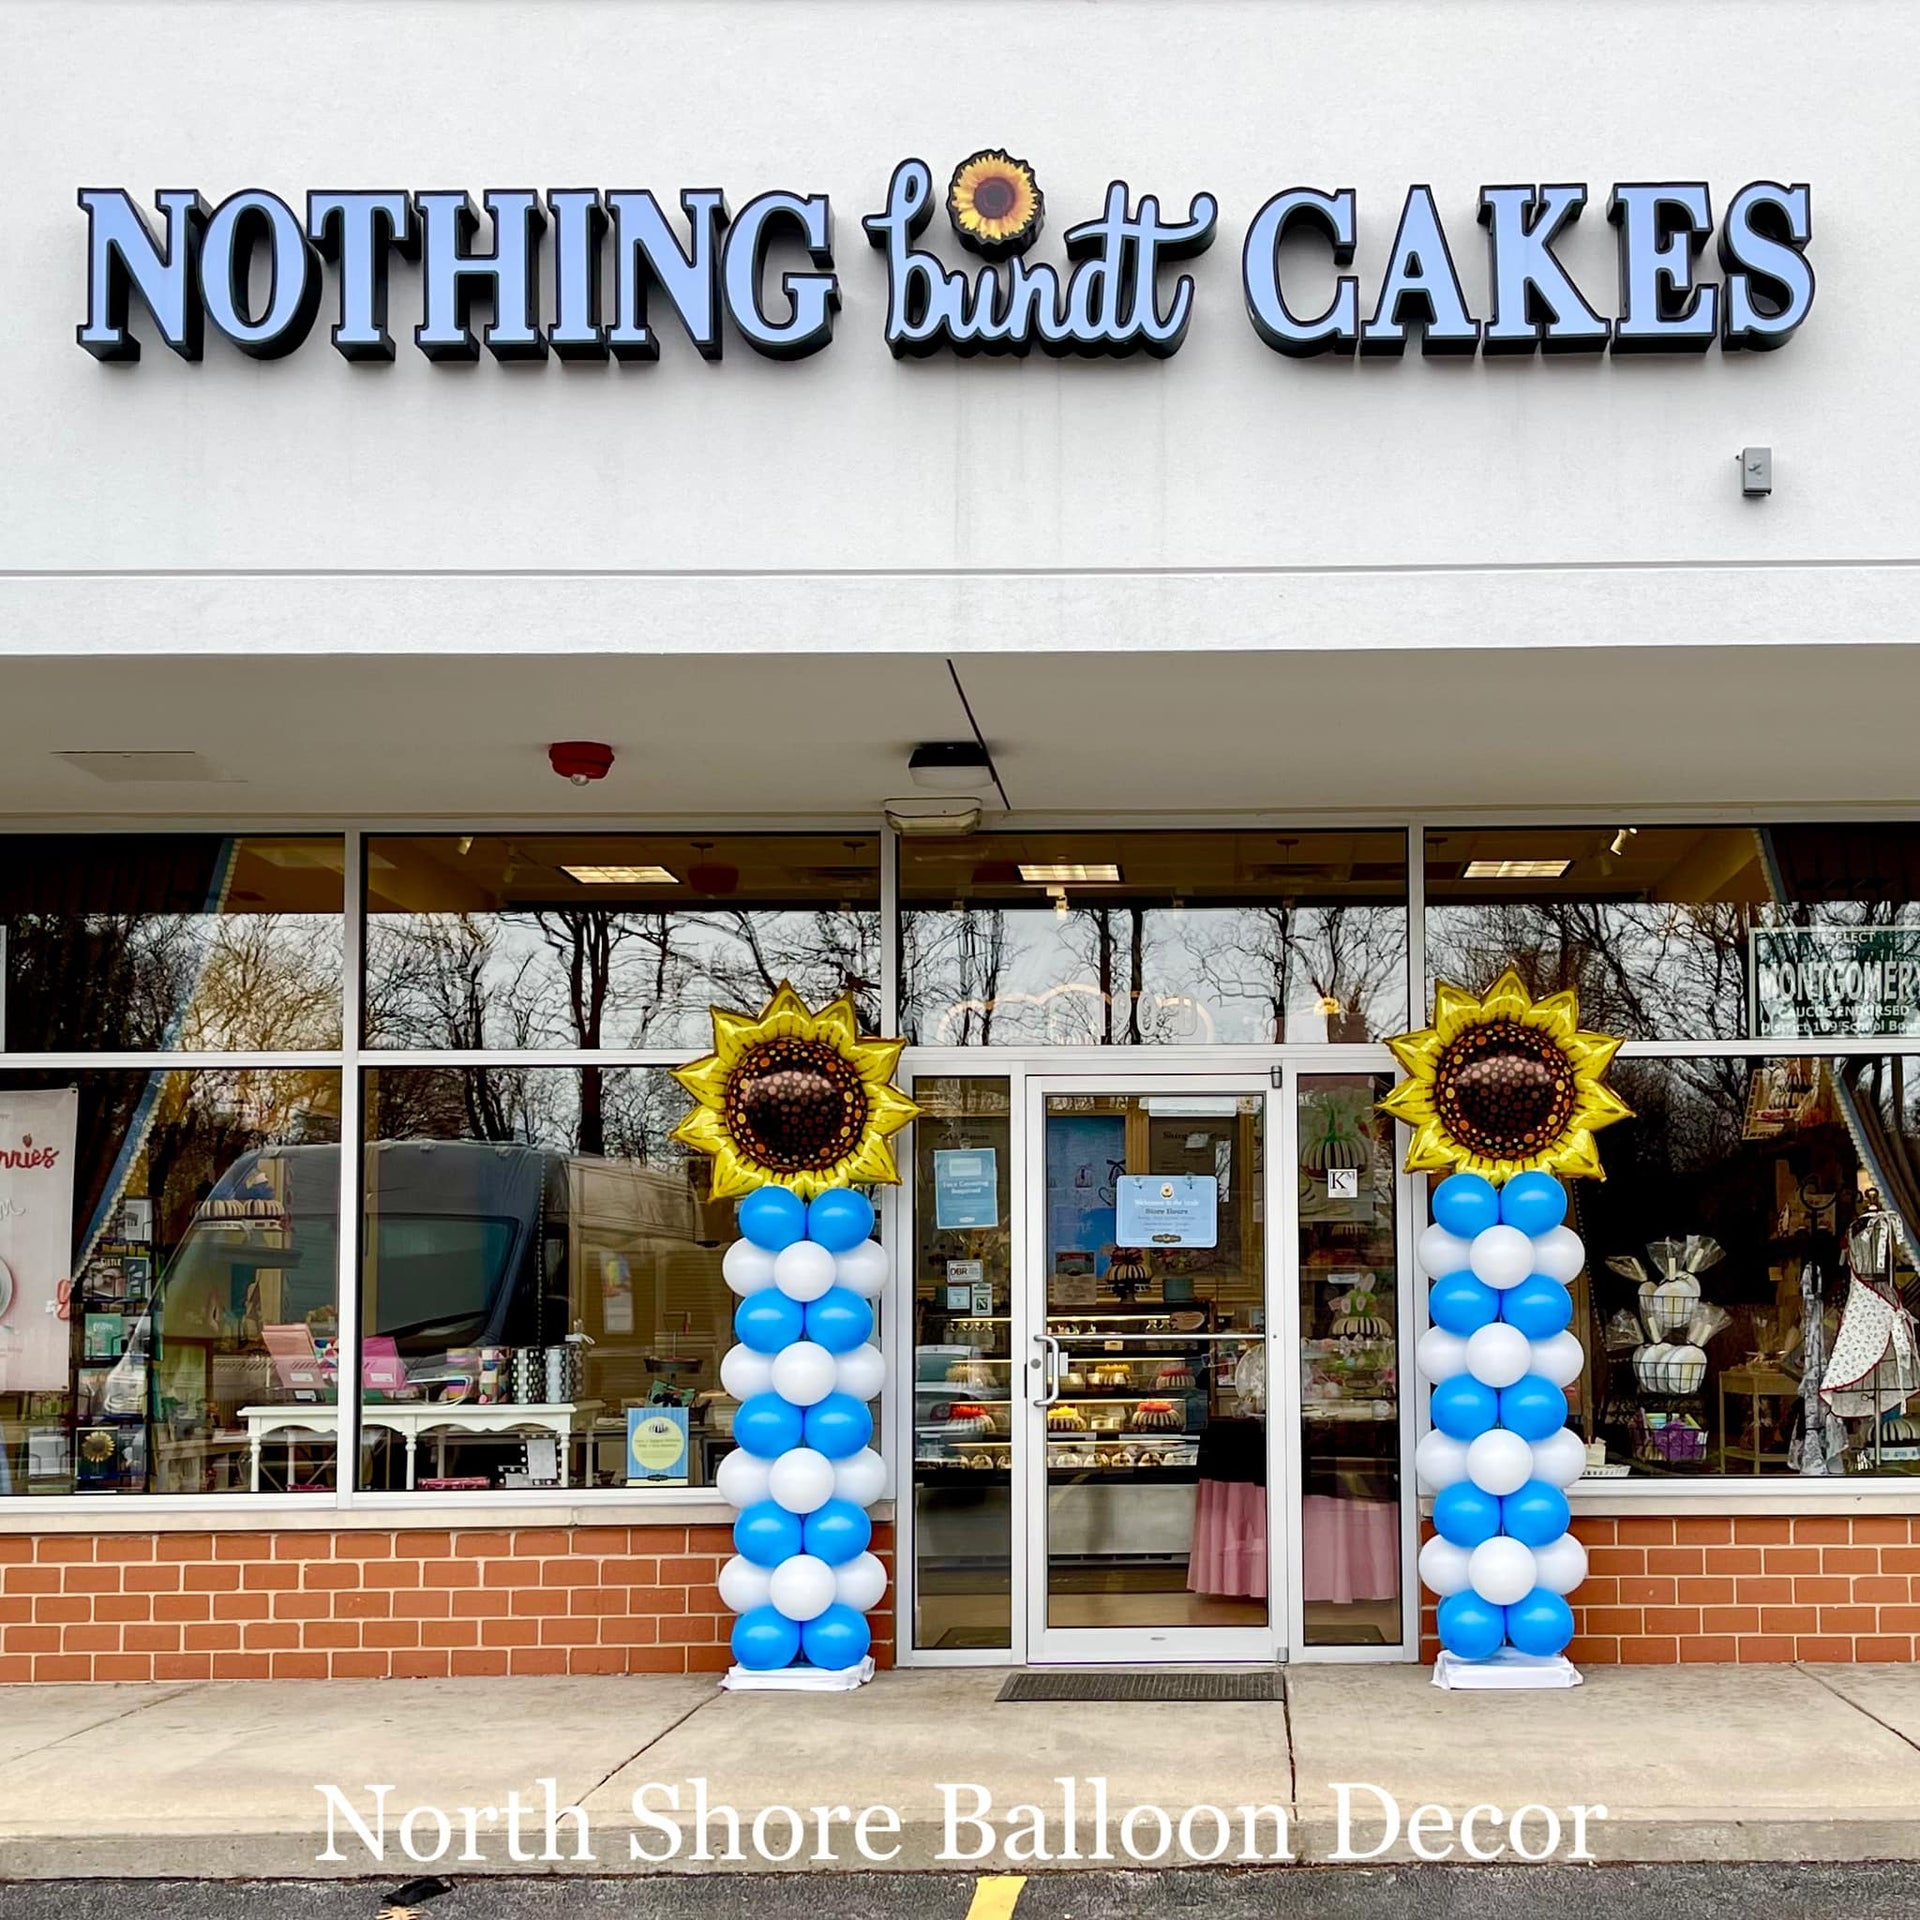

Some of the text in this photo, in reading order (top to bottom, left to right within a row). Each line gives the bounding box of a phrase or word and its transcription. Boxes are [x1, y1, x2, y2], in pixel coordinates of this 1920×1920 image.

[77, 158, 1816, 357] NOTHING bundt CAKES
[1779, 1005, 1910, 1018] CAUCUS ENDORSED
